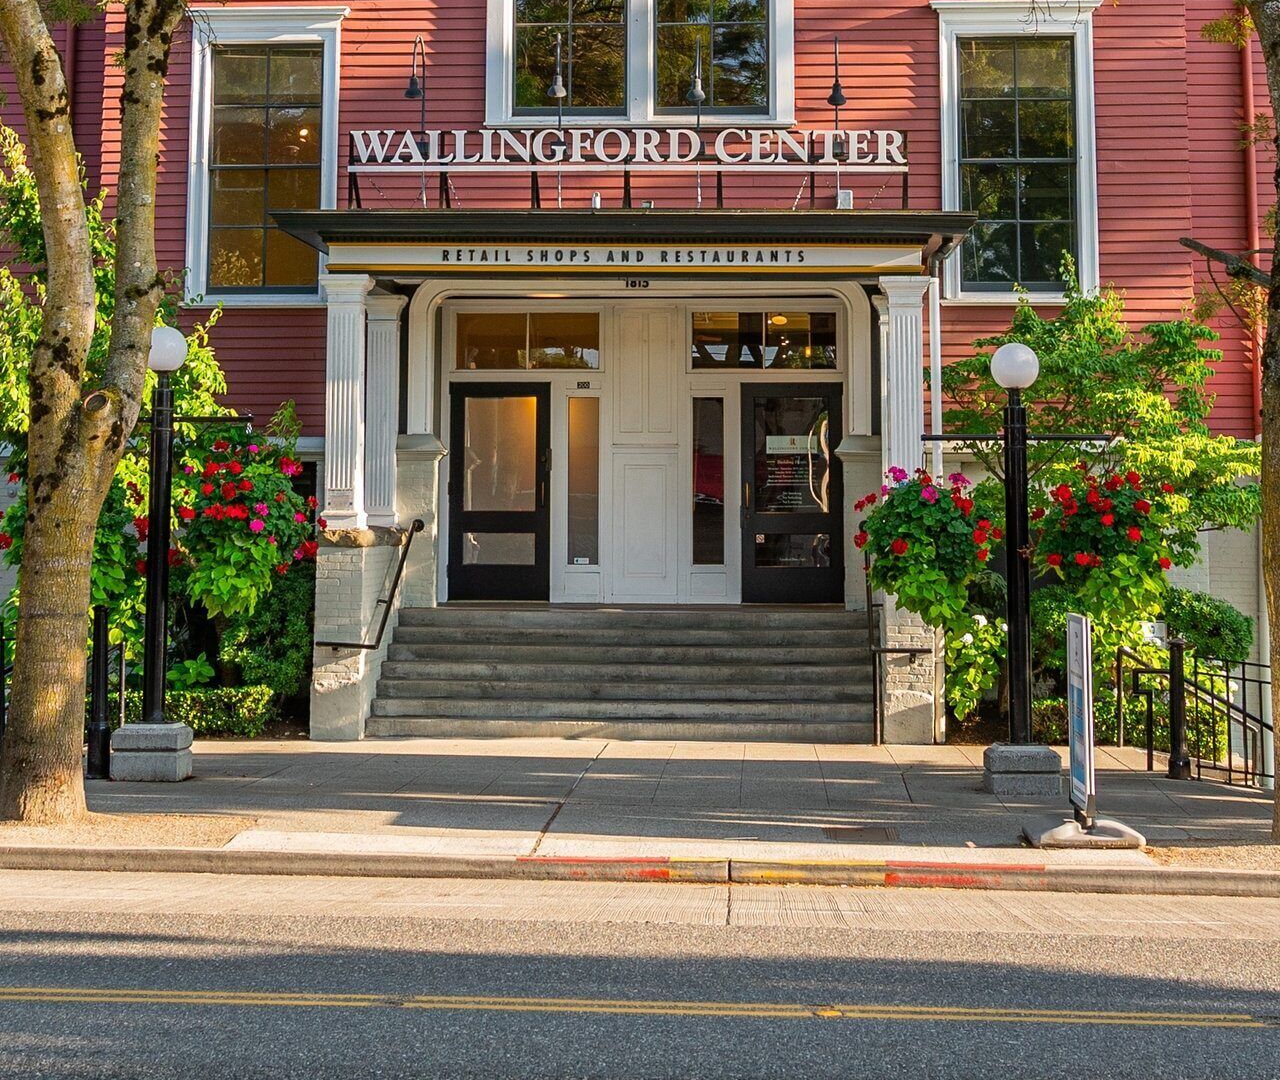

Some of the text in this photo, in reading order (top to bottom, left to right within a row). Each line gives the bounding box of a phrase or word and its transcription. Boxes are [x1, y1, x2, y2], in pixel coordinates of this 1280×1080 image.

[349, 128, 907, 164] WALLINGFORD CENTER
[442, 249, 805, 263] RETAIL SHOPS AND RESTAURANTS
